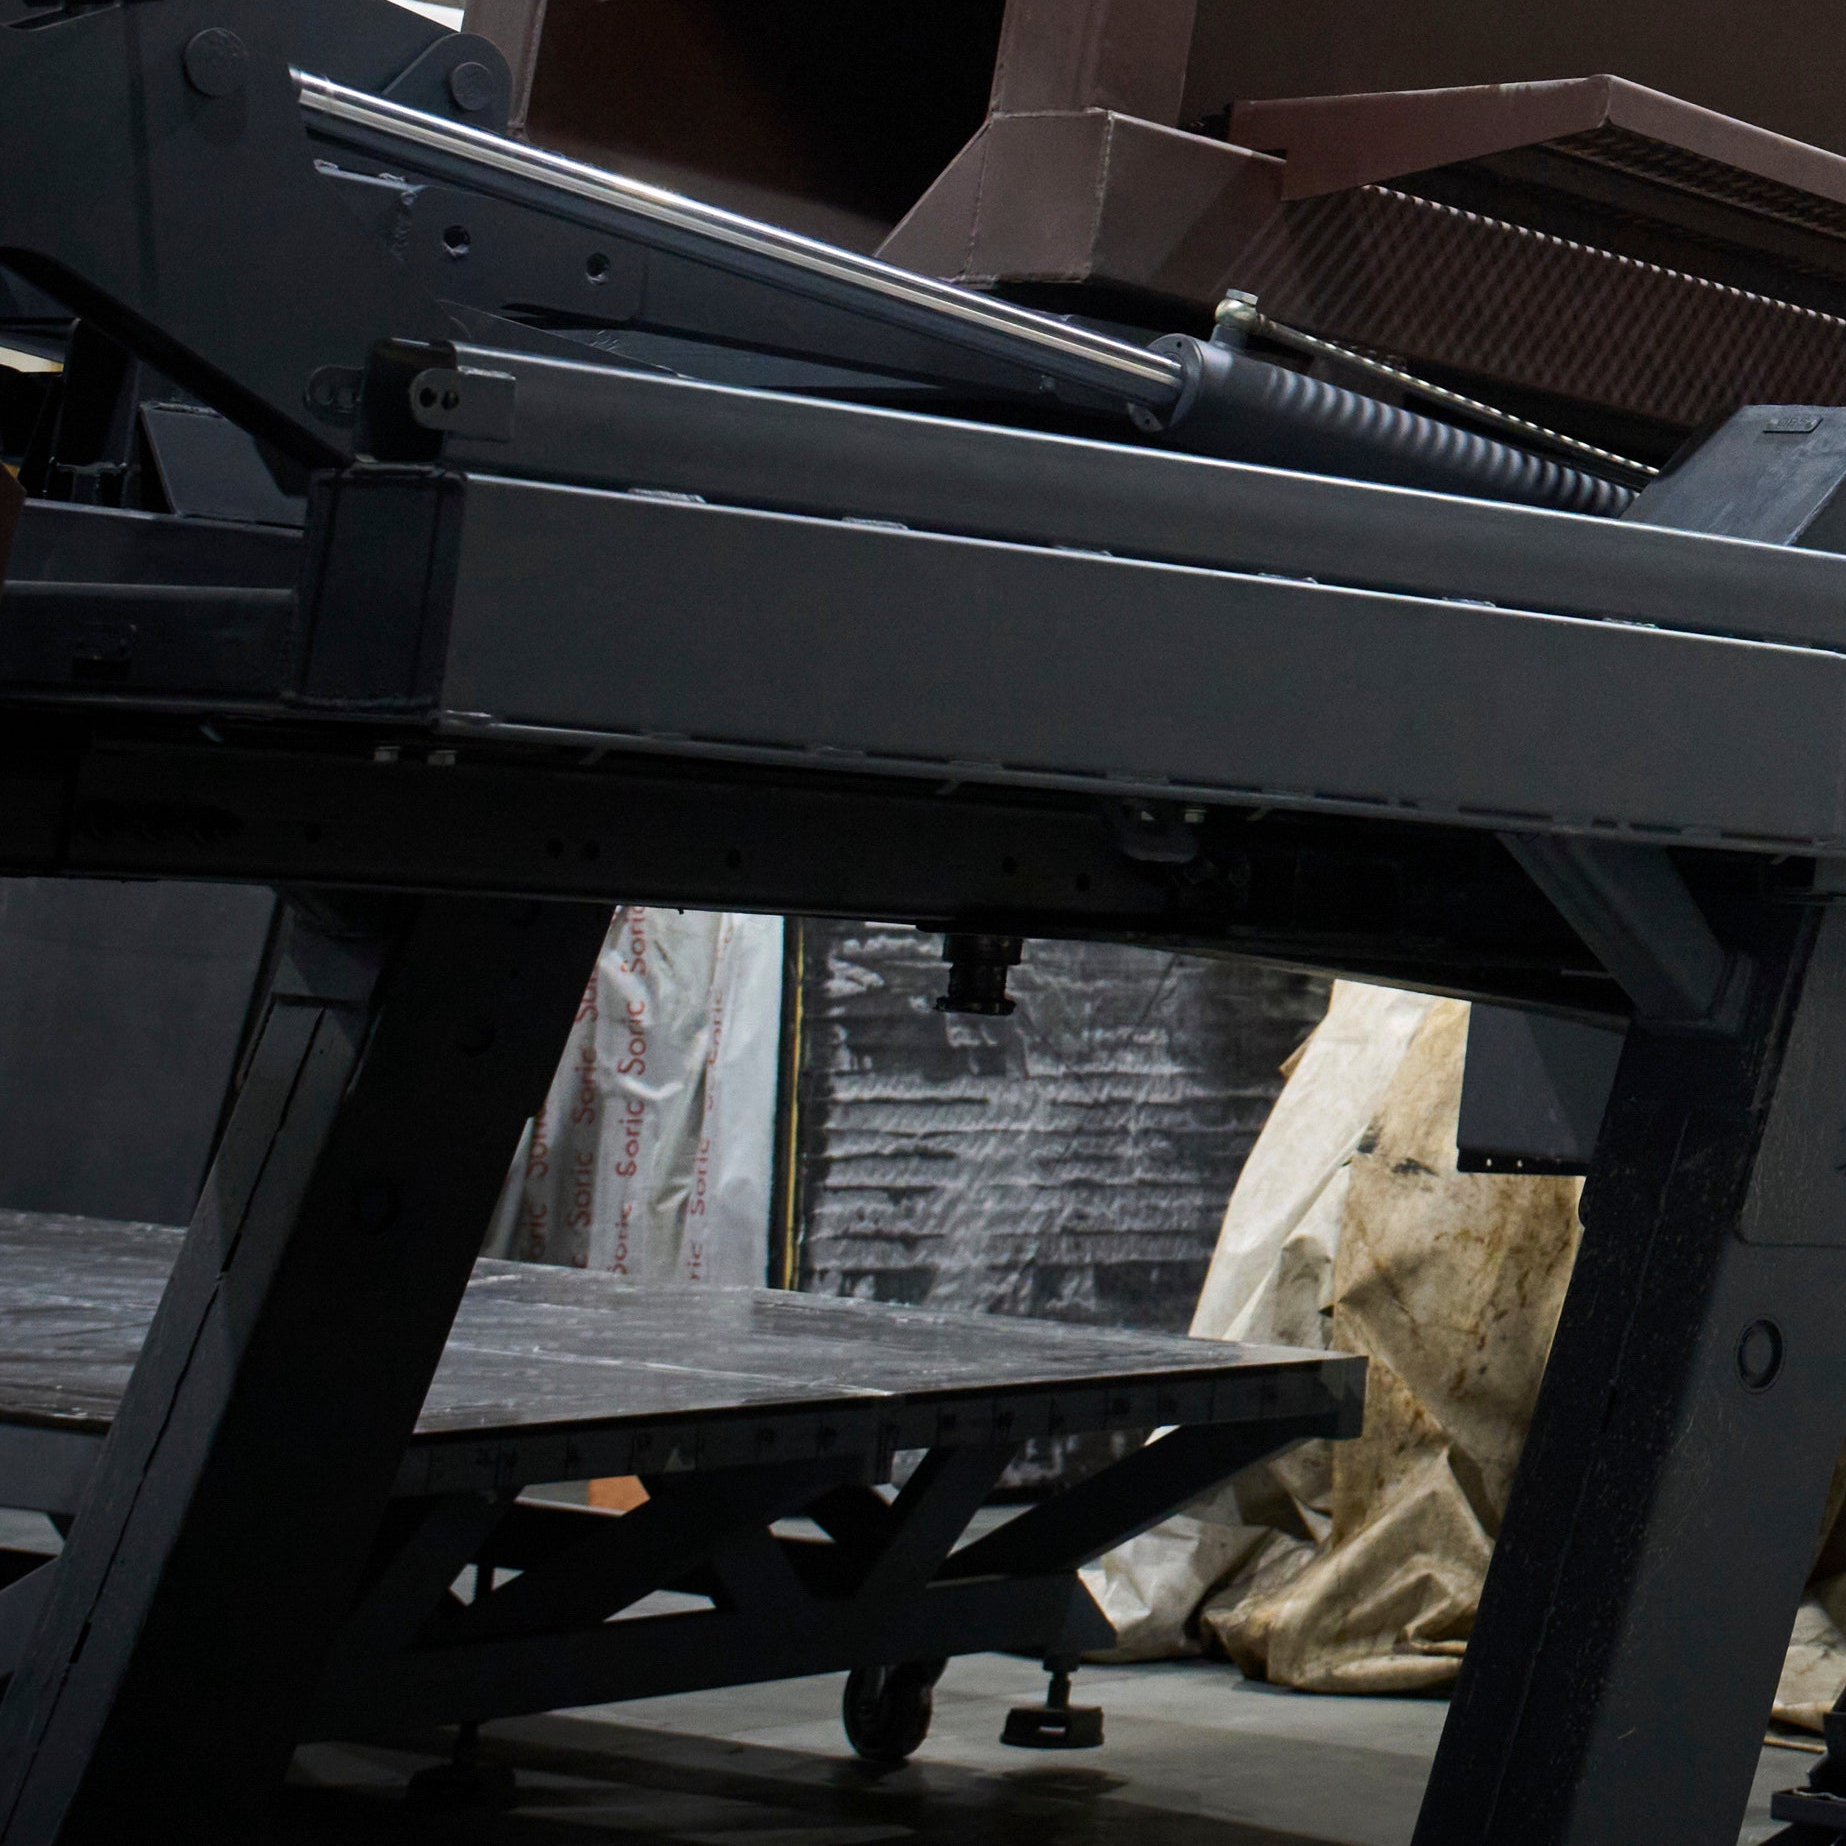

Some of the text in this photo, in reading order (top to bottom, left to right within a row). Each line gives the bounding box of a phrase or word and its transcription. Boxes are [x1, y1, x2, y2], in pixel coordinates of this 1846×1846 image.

[617, 1001, 647, 1076] Soric
[573, 1046, 597, 1124] Soric
[615, 1099, 645, 1177] Soric
[567, 1153, 593, 1227] Soric
[690, 1137, 711, 1216] Soric
[527, 1202, 548, 1259] oric
